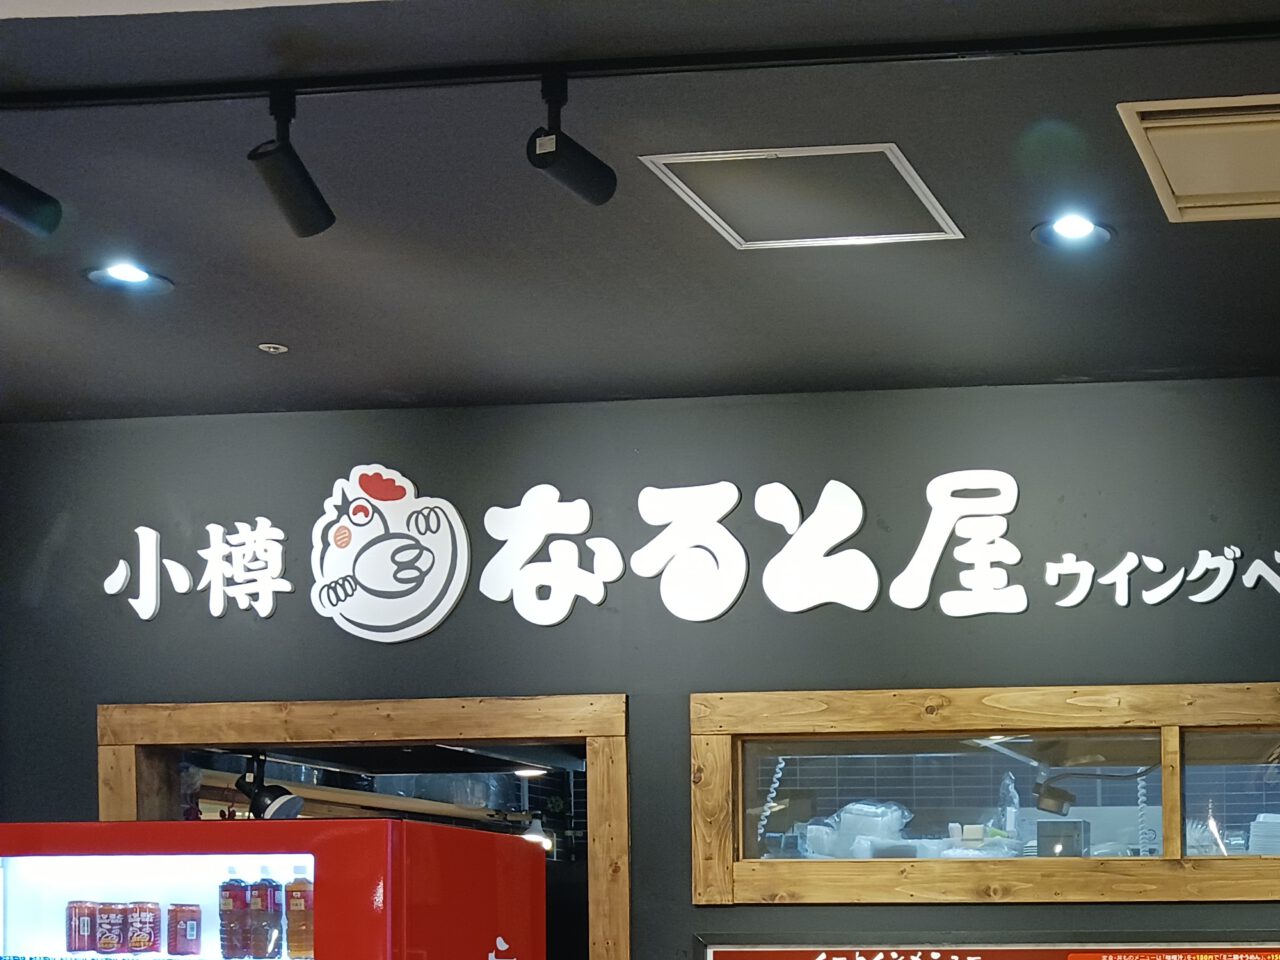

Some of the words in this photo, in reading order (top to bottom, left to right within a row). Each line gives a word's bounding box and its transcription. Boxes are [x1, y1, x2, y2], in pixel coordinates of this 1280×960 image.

[103, 515, 294, 620] 小樽
[479, 469, 1029, 626] なると屋
